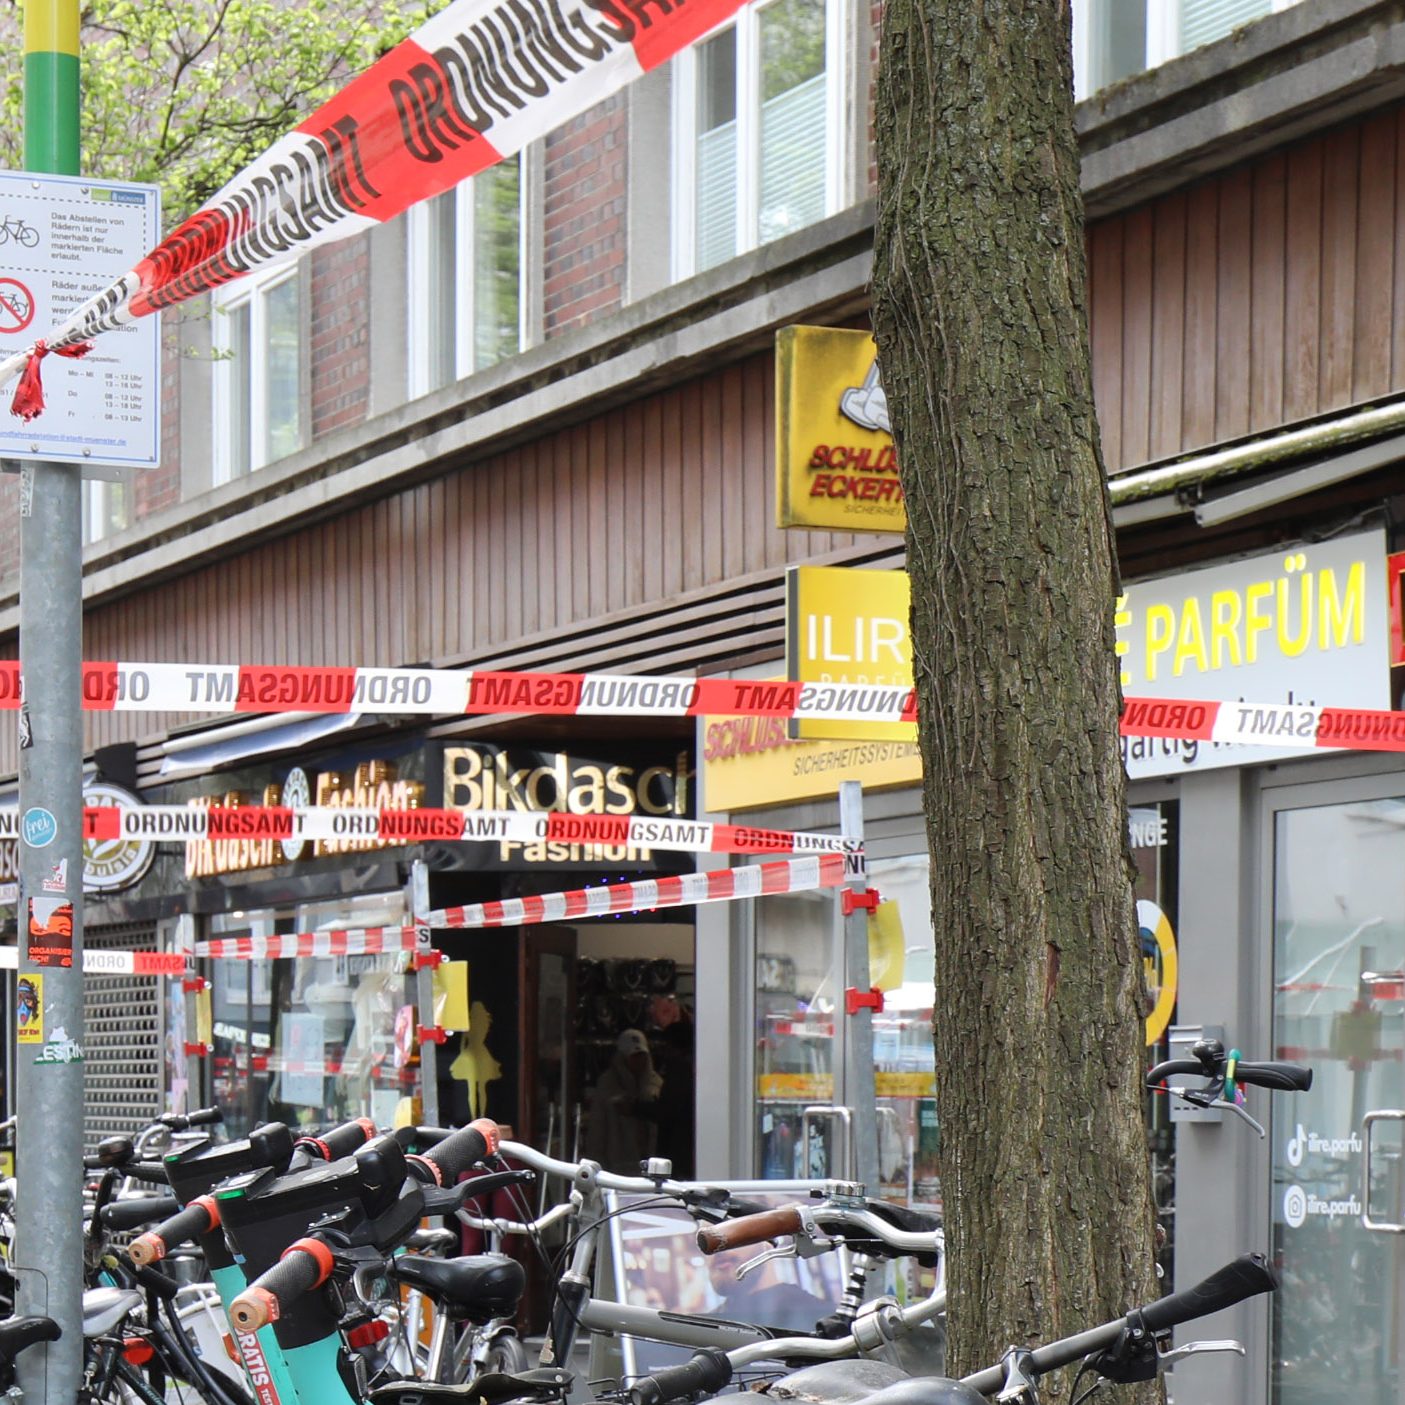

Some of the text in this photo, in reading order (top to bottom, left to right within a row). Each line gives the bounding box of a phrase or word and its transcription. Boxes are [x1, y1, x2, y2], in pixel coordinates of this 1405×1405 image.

[51, 212, 67, 221] Das
[69, 214, 107, 225] Abstellen
[51, 222, 108, 234] Rädern ist nur
[51, 232, 105, 244] innerhalb der
[51, 242, 124, 256] markierten Fläche
[51, 252, 82, 261] erlaubt.
[51, 280, 78, 290] Räder
[1146, 554, 1366, 682] PARFÜM
[807, 613, 906, 665] ILIR
[26, 814, 51, 842] frei
[125, 813, 307, 834] ORDNUNGSAMT
[332, 813, 511, 838] ORDNUNGSAMT
[535, 816, 710, 845] ORDNUNGSAMT
[733, 827, 865, 853] ORDNUNGSA
[235, 1328, 270, 1387] RATIS
